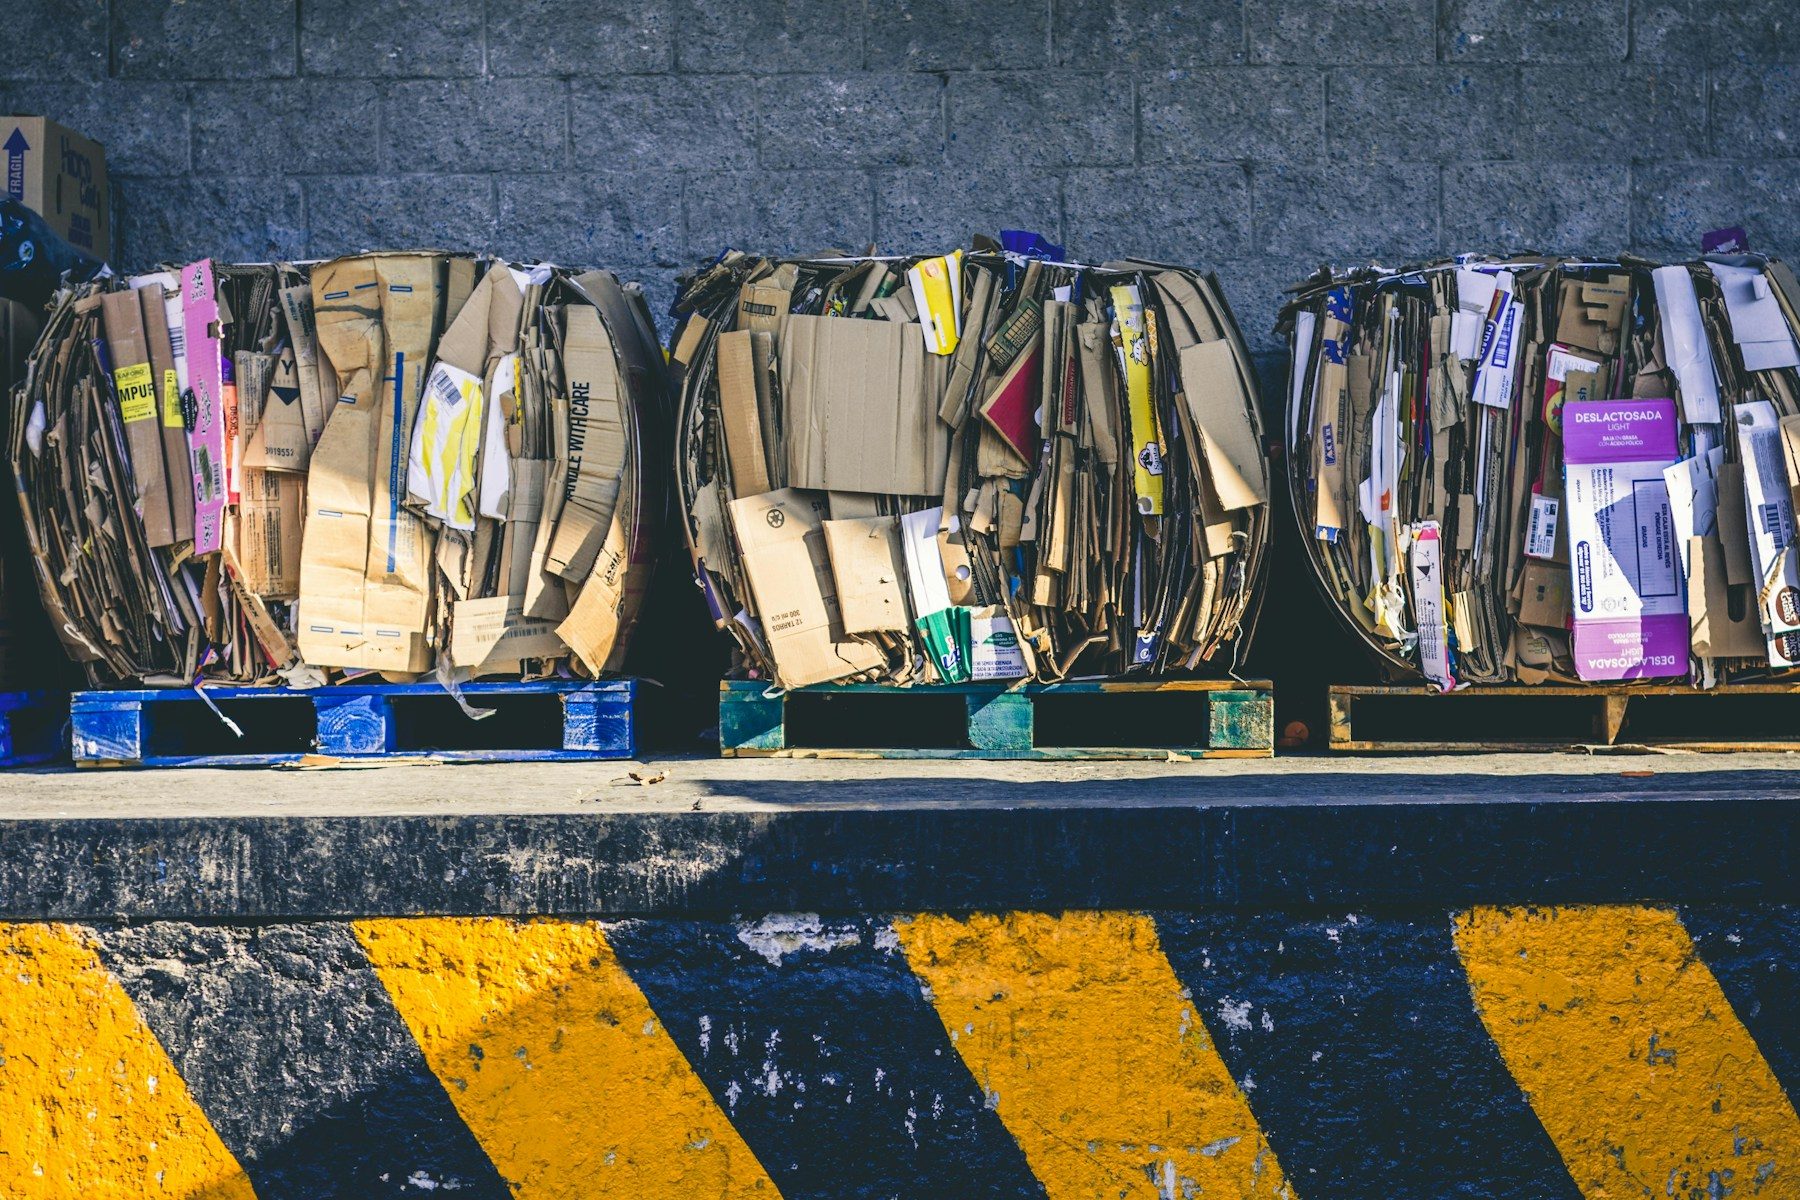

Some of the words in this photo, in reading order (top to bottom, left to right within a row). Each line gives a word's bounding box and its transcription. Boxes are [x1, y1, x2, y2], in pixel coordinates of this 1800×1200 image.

[10, 153, 22, 194] FRAGIL
[571, 381, 590, 417] CARE
[1575, 410, 1663, 423] DESLACTOSADA
[1607, 423, 1630, 431] LIGHT
[569, 416, 588, 452] WITH
[392, 423, 400, 466] INSTRUCTIONS
[789, 609, 801, 617] 300
[772, 620, 796, 632] TARROS
[795, 619, 803, 627] 12
[1620, 647, 1644, 656] LIGHT
[1588, 655, 1675, 669] DESLACTOSADA
